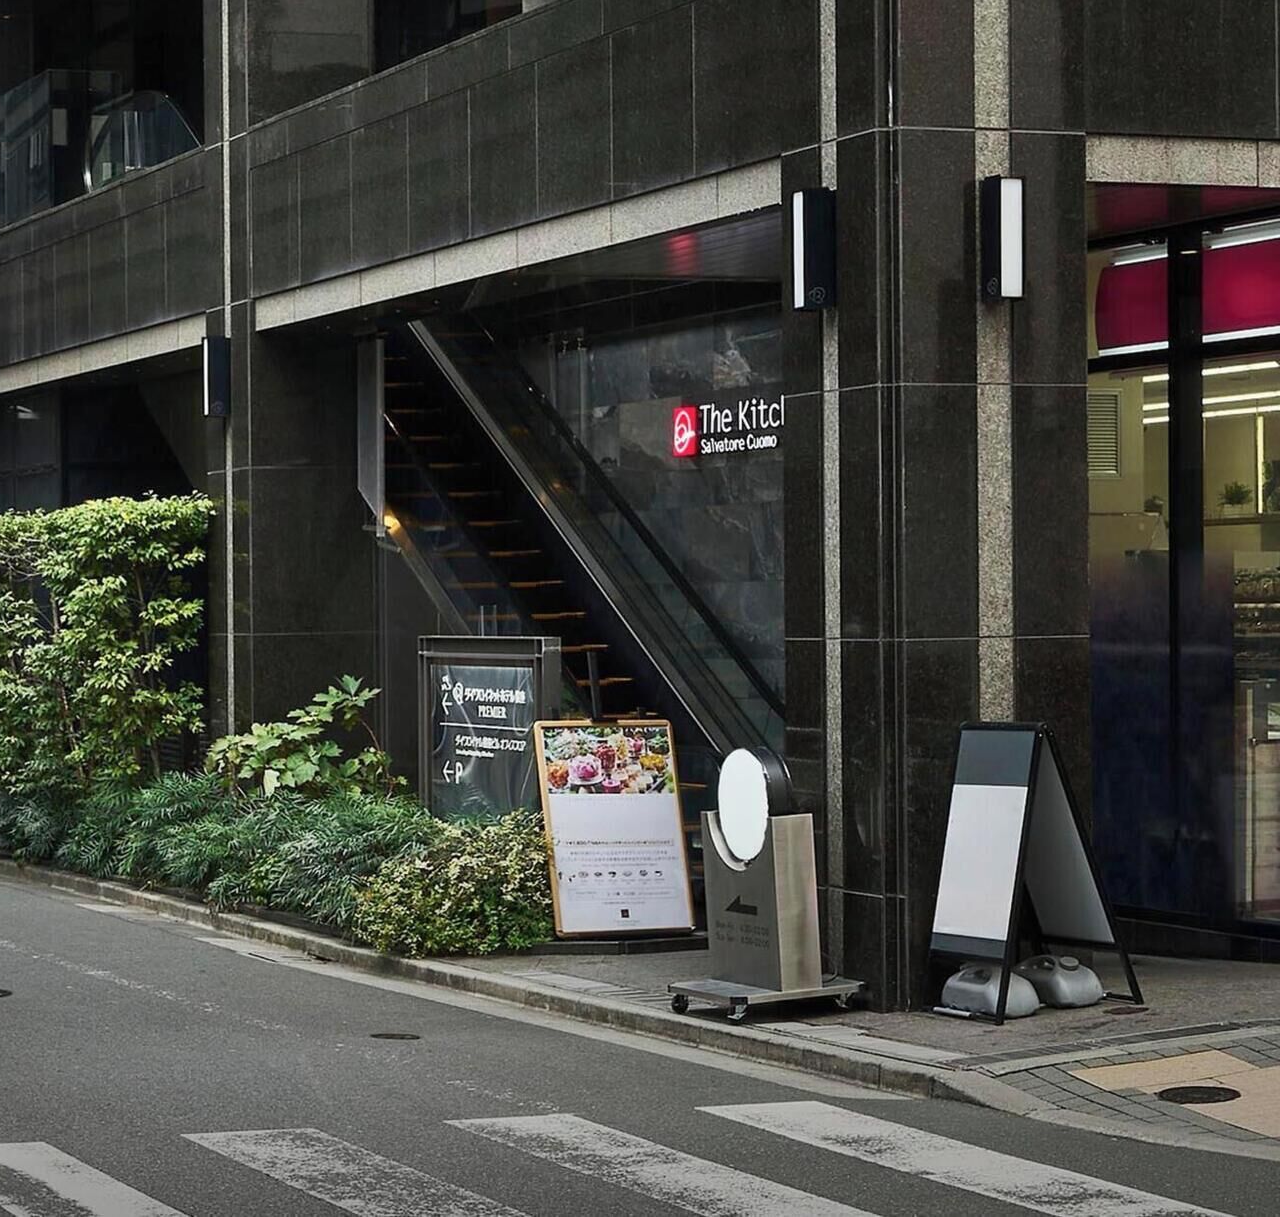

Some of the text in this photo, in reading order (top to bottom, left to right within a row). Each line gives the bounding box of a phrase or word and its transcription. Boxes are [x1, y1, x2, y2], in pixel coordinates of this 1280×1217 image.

[699, 403, 732, 434] The
[700, 434, 778, 455] Salvatore Cuomo
[455, 761, 464, 784] P
